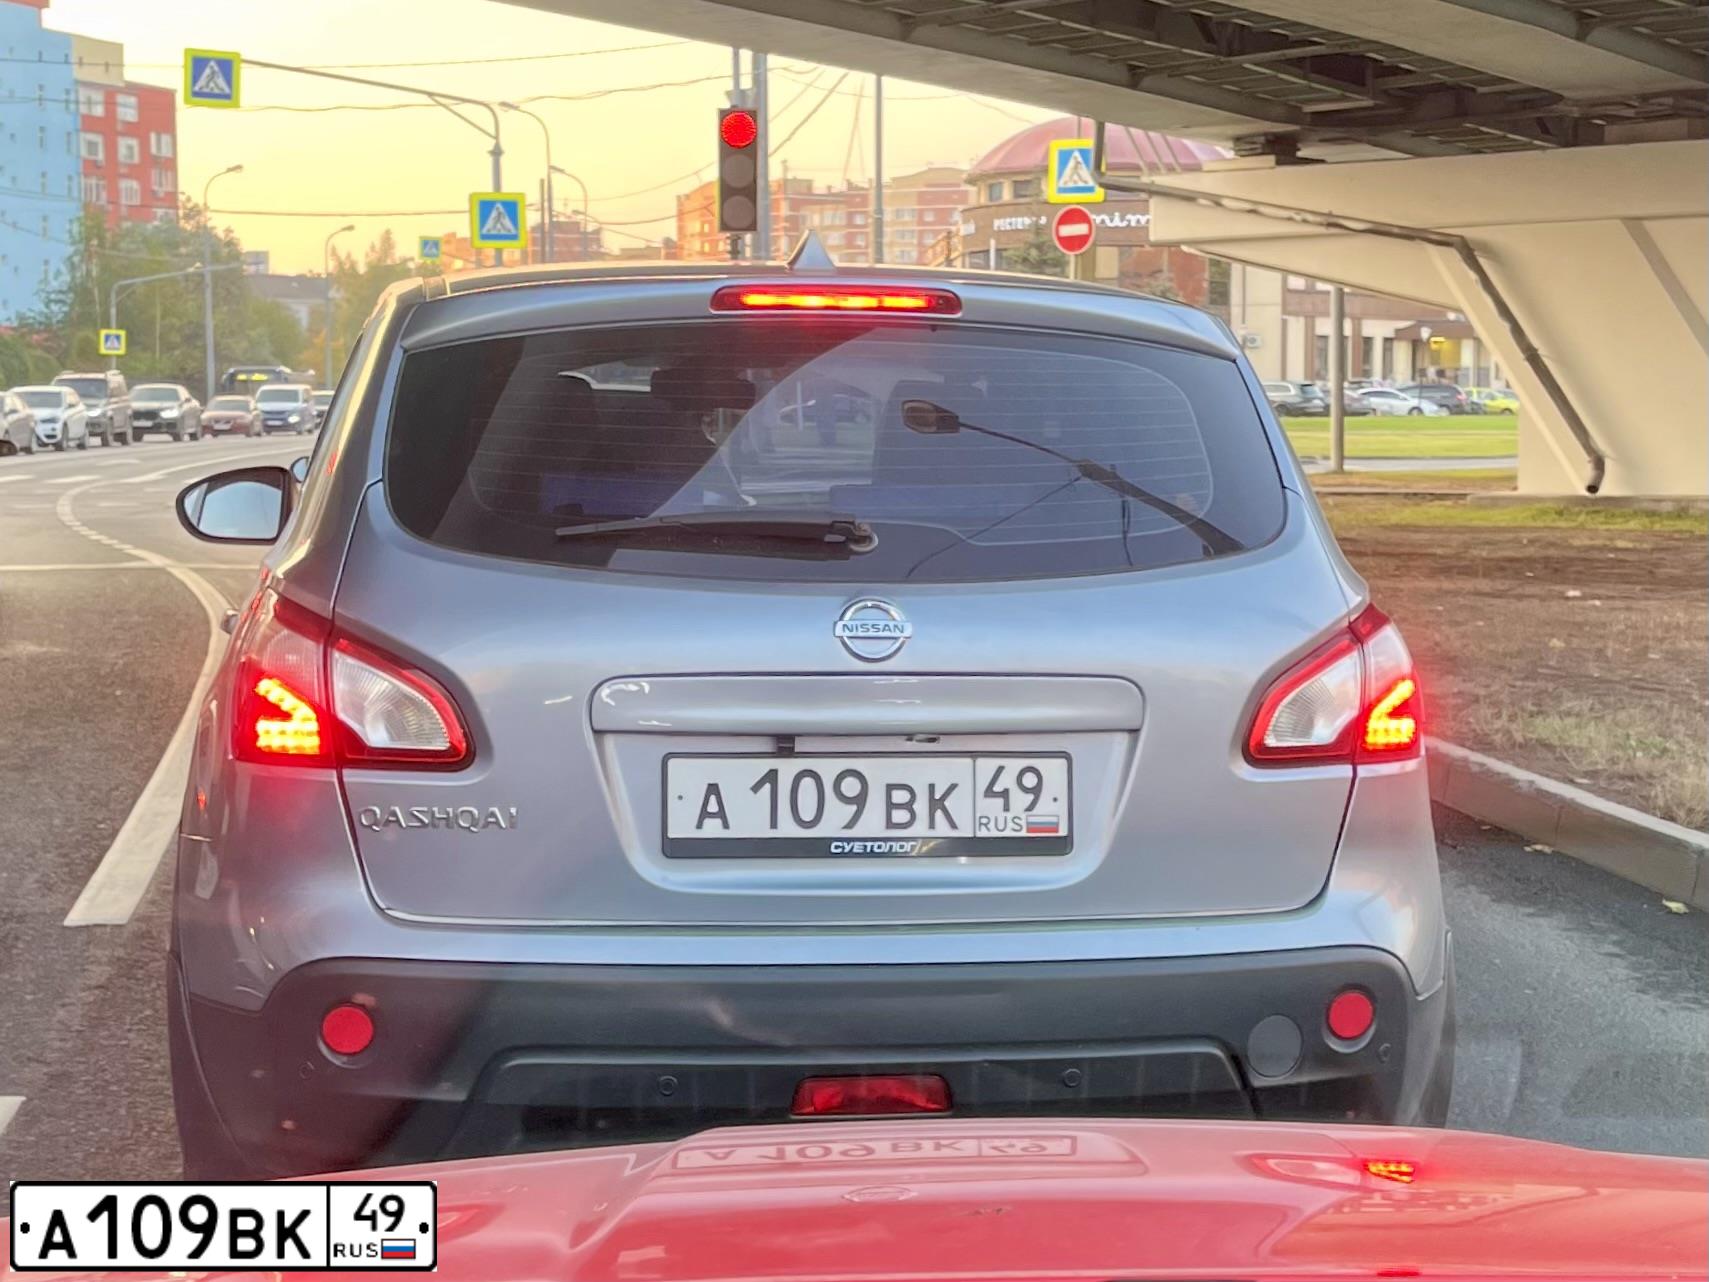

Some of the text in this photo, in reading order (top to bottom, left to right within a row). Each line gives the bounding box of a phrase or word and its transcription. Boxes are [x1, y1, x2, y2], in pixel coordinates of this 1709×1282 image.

[842, 623, 904, 634] NISSAN
[983, 765, 1044, 813] 49
[359, 805, 518, 832] QASHQAI
[978, 815, 1023, 833] RUS
[830, 840, 917, 854] СУЕТОЛОГ
